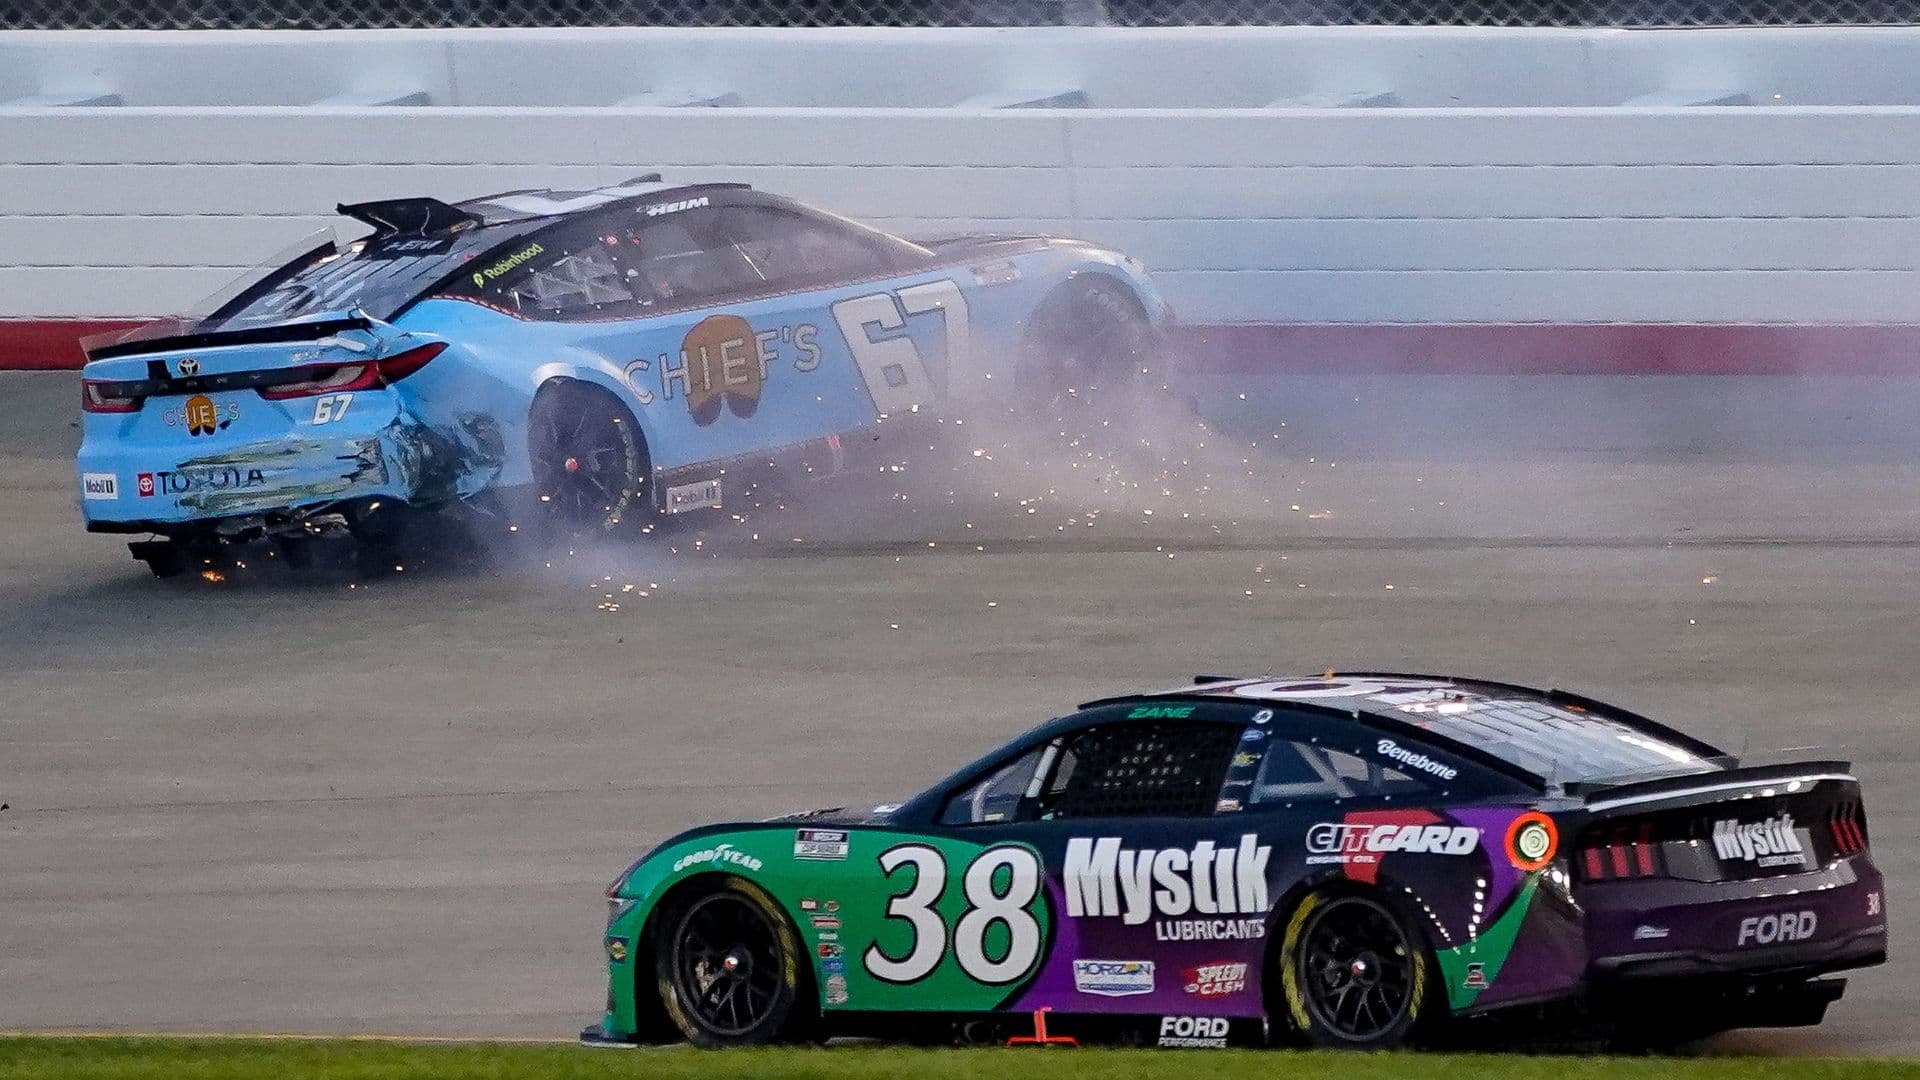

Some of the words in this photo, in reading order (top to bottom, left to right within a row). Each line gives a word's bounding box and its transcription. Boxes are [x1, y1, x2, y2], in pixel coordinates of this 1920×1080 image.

[485, 243, 544, 280] Robinhood
[832, 279, 970, 414] 67
[623, 323, 822, 406] CHIEF'S
[313, 395, 353, 425] 67
[86, 479, 106, 494] Mobil
[156, 468, 265, 495] TOOTA
[1127, 706, 1196, 719] ZANE
[1376, 738, 1458, 781] Benebone
[1712, 813, 1802, 861] Mystik
[1064, 834, 1272, 926] Mystik
[864, 843, 1043, 984] 38
[1155, 918, 1266, 941] LUBRICANTS
[1737, 910, 1817, 946] FORD
[1076, 962, 1151, 976] HORIZON
[1200, 980, 1245, 995] CASH
[1159, 1016, 1231, 1038] FORD
